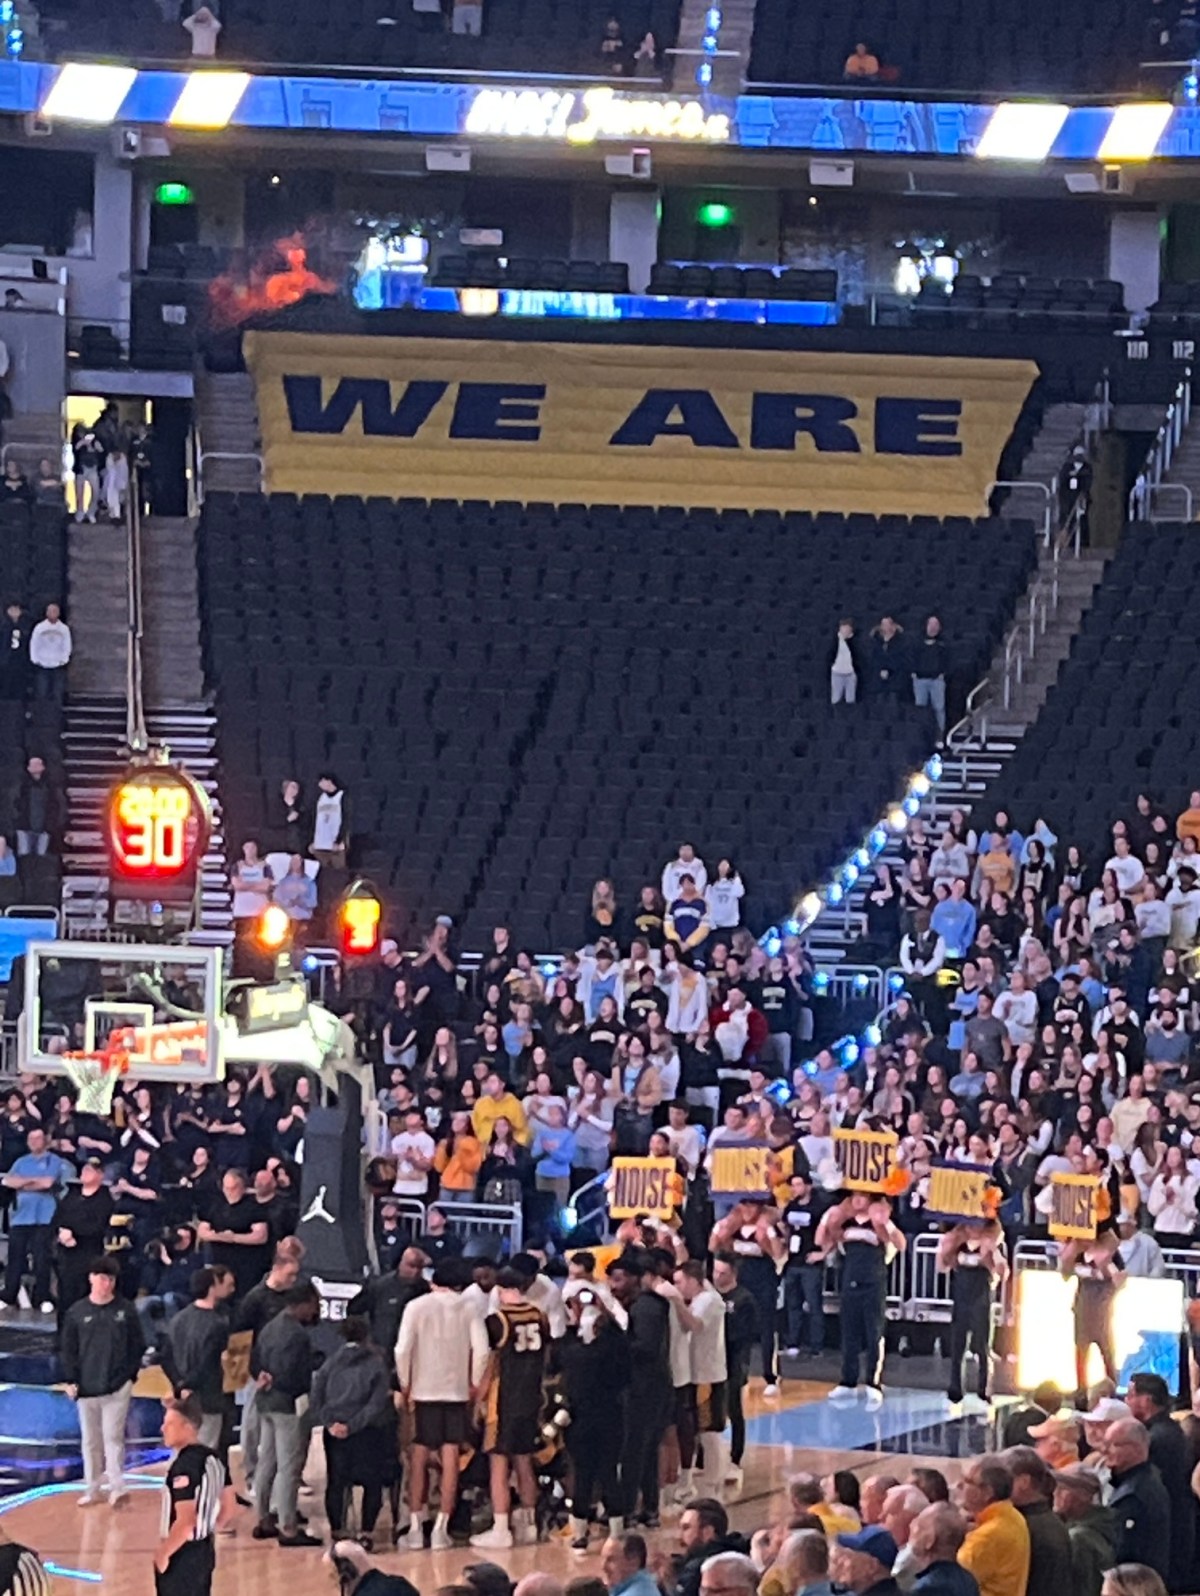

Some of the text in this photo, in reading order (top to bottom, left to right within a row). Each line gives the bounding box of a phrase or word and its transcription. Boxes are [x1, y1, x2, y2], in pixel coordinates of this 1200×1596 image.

[1172, 341, 1195, 359] 112
[282, 374, 963, 456] WE ARE
[125, 818, 184, 867] 30
[835, 1139, 892, 1182] NOISE
[614, 1167, 672, 1208] NOISE
[514, 1323, 542, 1352] 35
